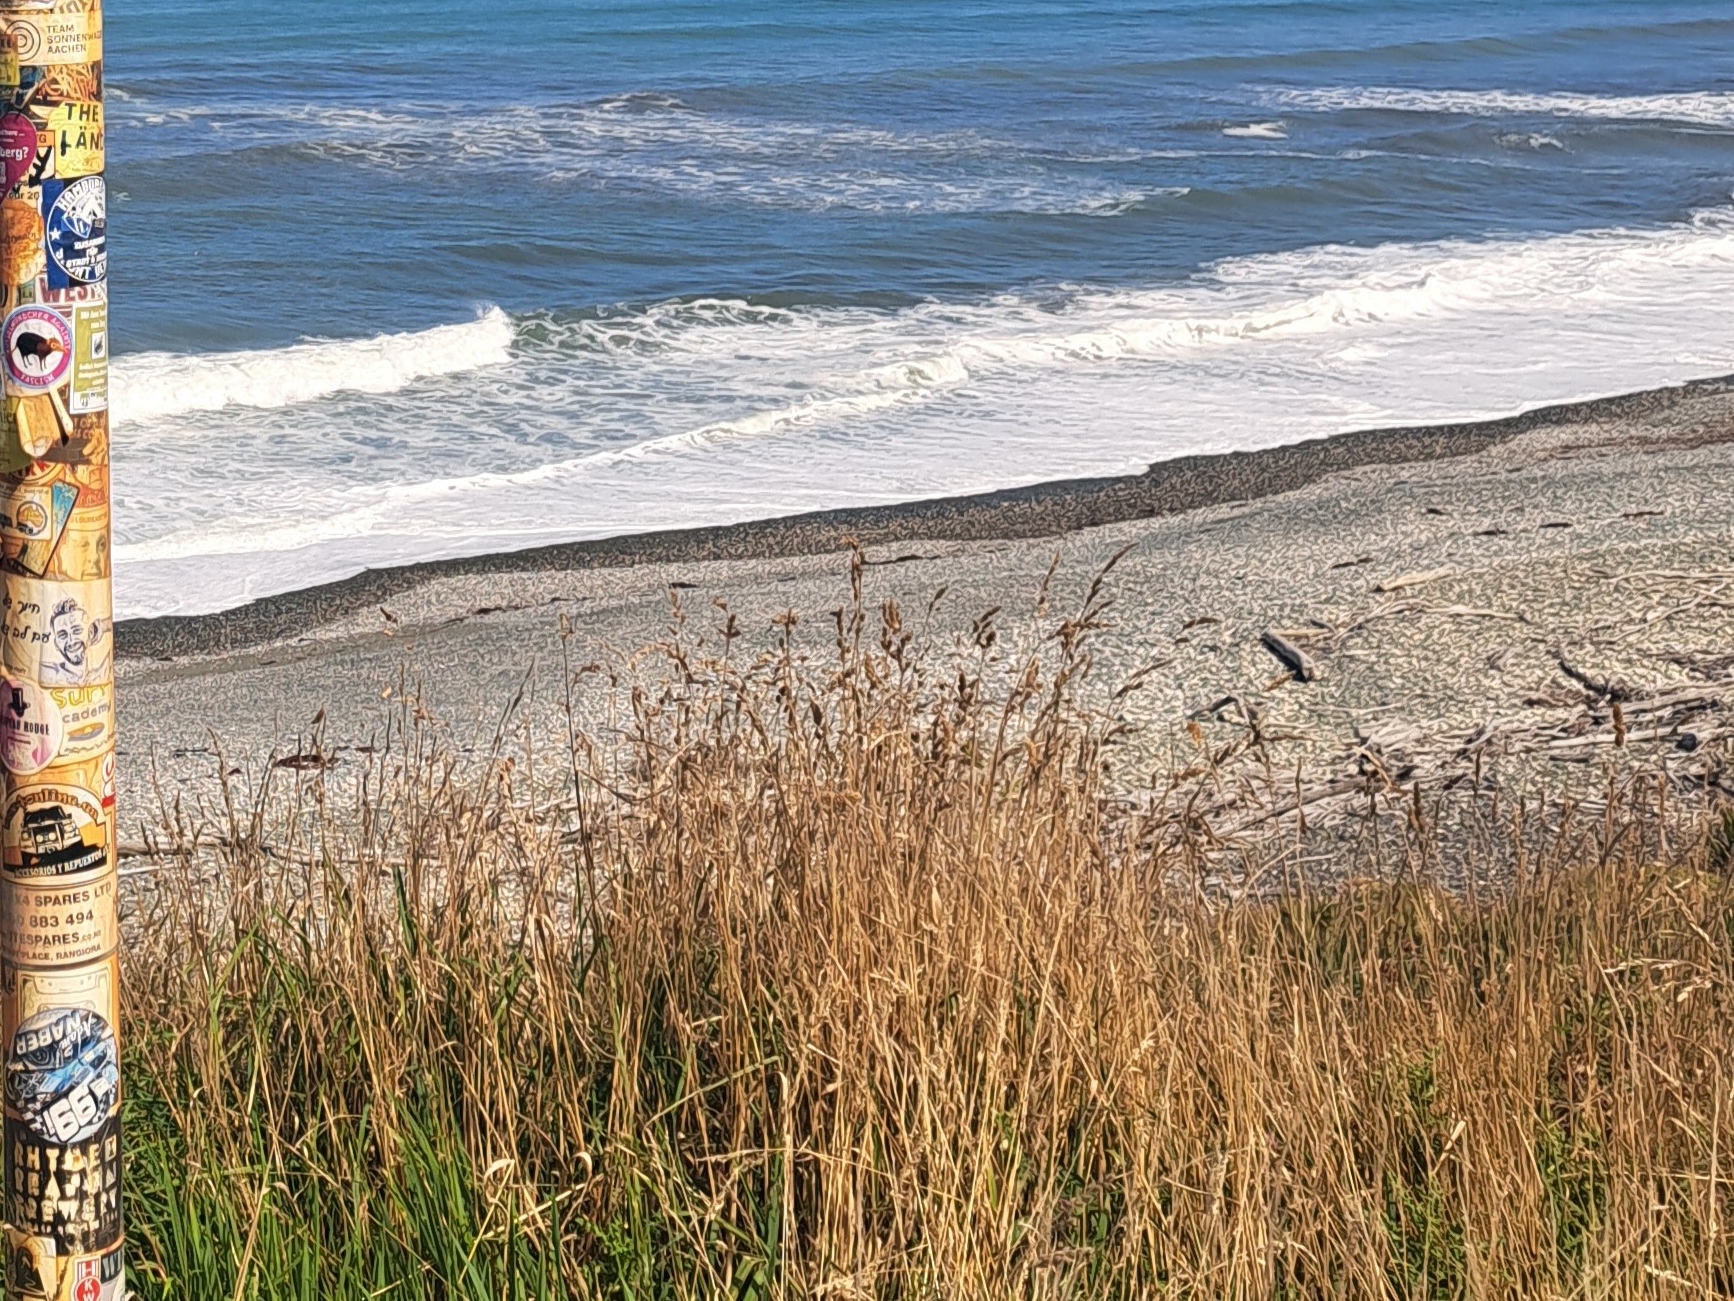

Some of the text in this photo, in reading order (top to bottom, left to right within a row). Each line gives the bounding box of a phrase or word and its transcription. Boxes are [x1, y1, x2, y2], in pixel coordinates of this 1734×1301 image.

[47, 24, 74, 35] TEAM
[47, 44, 87, 54] AACHEN
[65, 102, 99, 122] THE
[19, 373, 55, 386] FASCISM
[58, 864, 63, 873] Y
[34, 890, 90, 907] SPARES
[94, 881, 112, 898] LTD
[29, 914, 59, 928] 883
[66, 908, 94, 926] 494
[56, 943, 102, 960] RANGIORA
